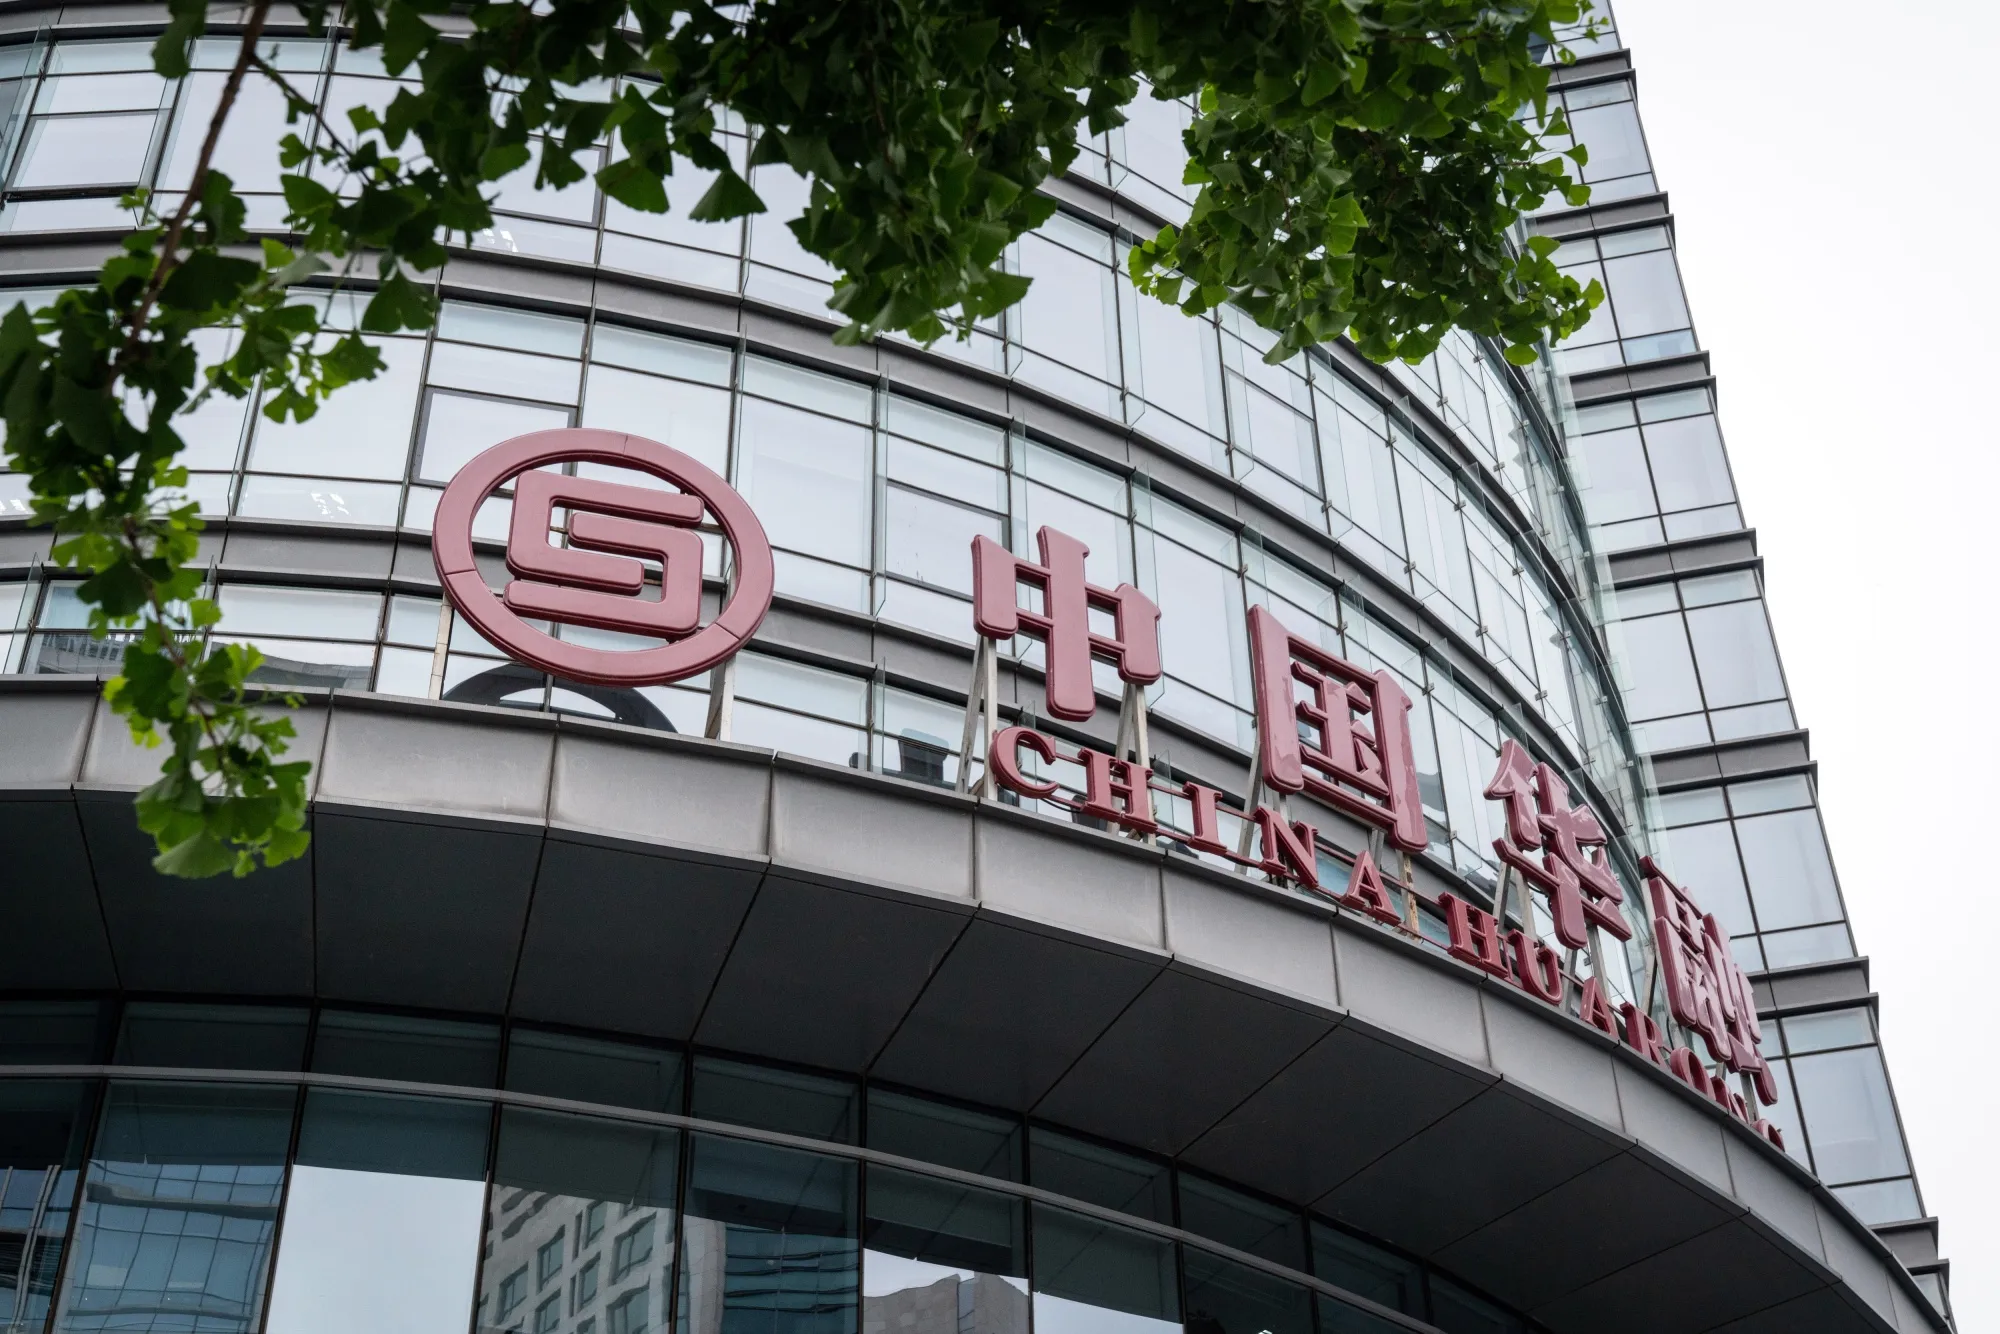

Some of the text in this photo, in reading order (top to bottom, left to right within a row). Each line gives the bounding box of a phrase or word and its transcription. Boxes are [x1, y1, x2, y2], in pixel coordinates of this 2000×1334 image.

[971, 525, 1779, 1106] 中国华融
[988, 726, 1403, 926] CHINA
